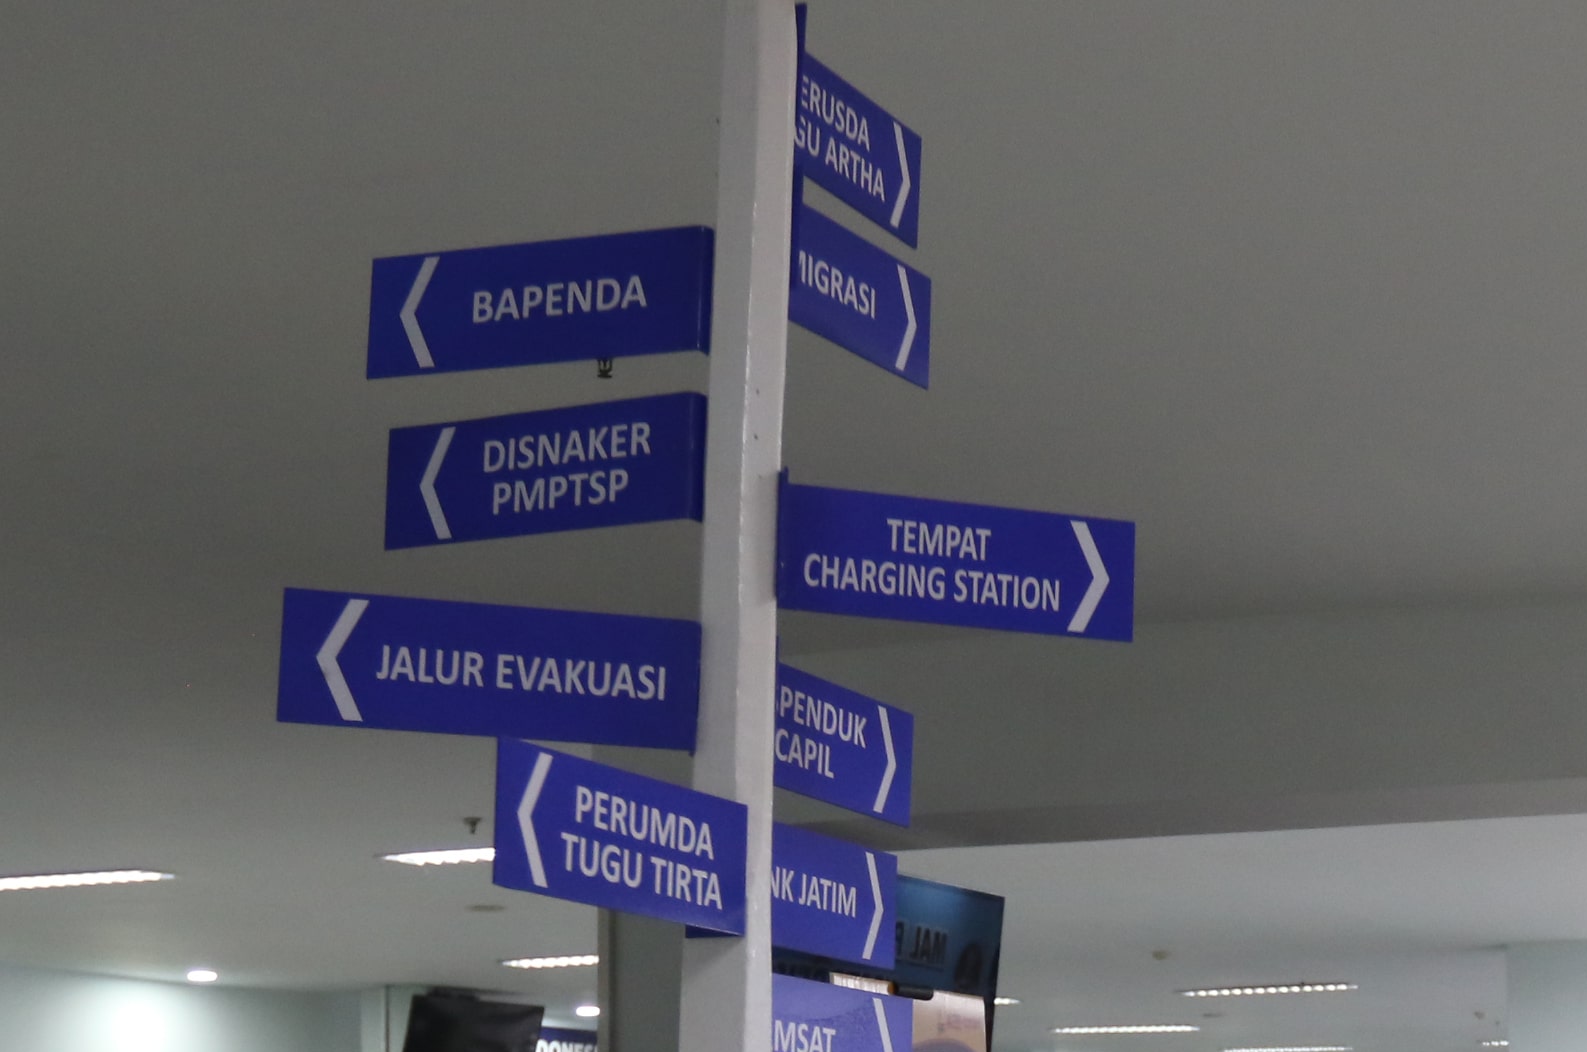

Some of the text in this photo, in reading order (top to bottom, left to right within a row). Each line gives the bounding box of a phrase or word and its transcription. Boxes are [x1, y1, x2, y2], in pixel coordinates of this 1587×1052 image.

[825, 137, 885, 203] ARTHA
[472, 275, 647, 323] BAPENDA
[483, 421, 651, 473] DISNAKER
[492, 468, 629, 515] PMPTSP
[887, 518, 991, 561] TEMPAT
[803, 553, 1060, 612] CHARGING STATION
[376, 645, 666, 701] JALUR EVAKUASI
[777, 685, 867, 749] PENDUK
[775, 728, 835, 779] CAPIL
[575, 785, 715, 861] PERUMDA
[560, 831, 723, 910] TUGU TIRTA
[798, 873, 857, 918] JATIM
